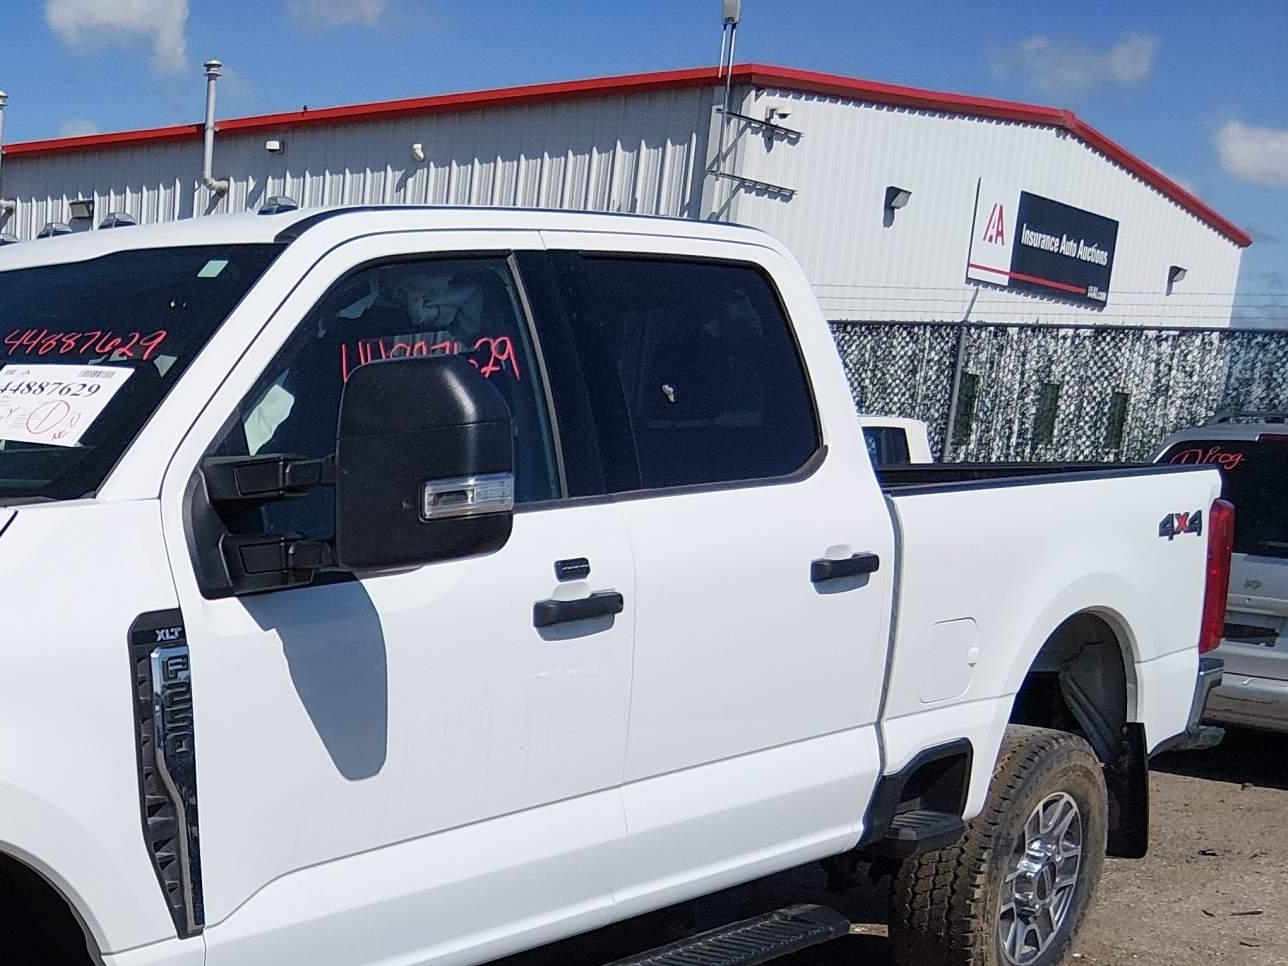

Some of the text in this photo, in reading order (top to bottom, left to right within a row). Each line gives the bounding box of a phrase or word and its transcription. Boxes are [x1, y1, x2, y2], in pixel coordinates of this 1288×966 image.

[1020, 223, 1109, 266] Insurance Auto Auctions
[4, 328, 169, 362] 44887629
[154, 626, 183, 642] XLT
